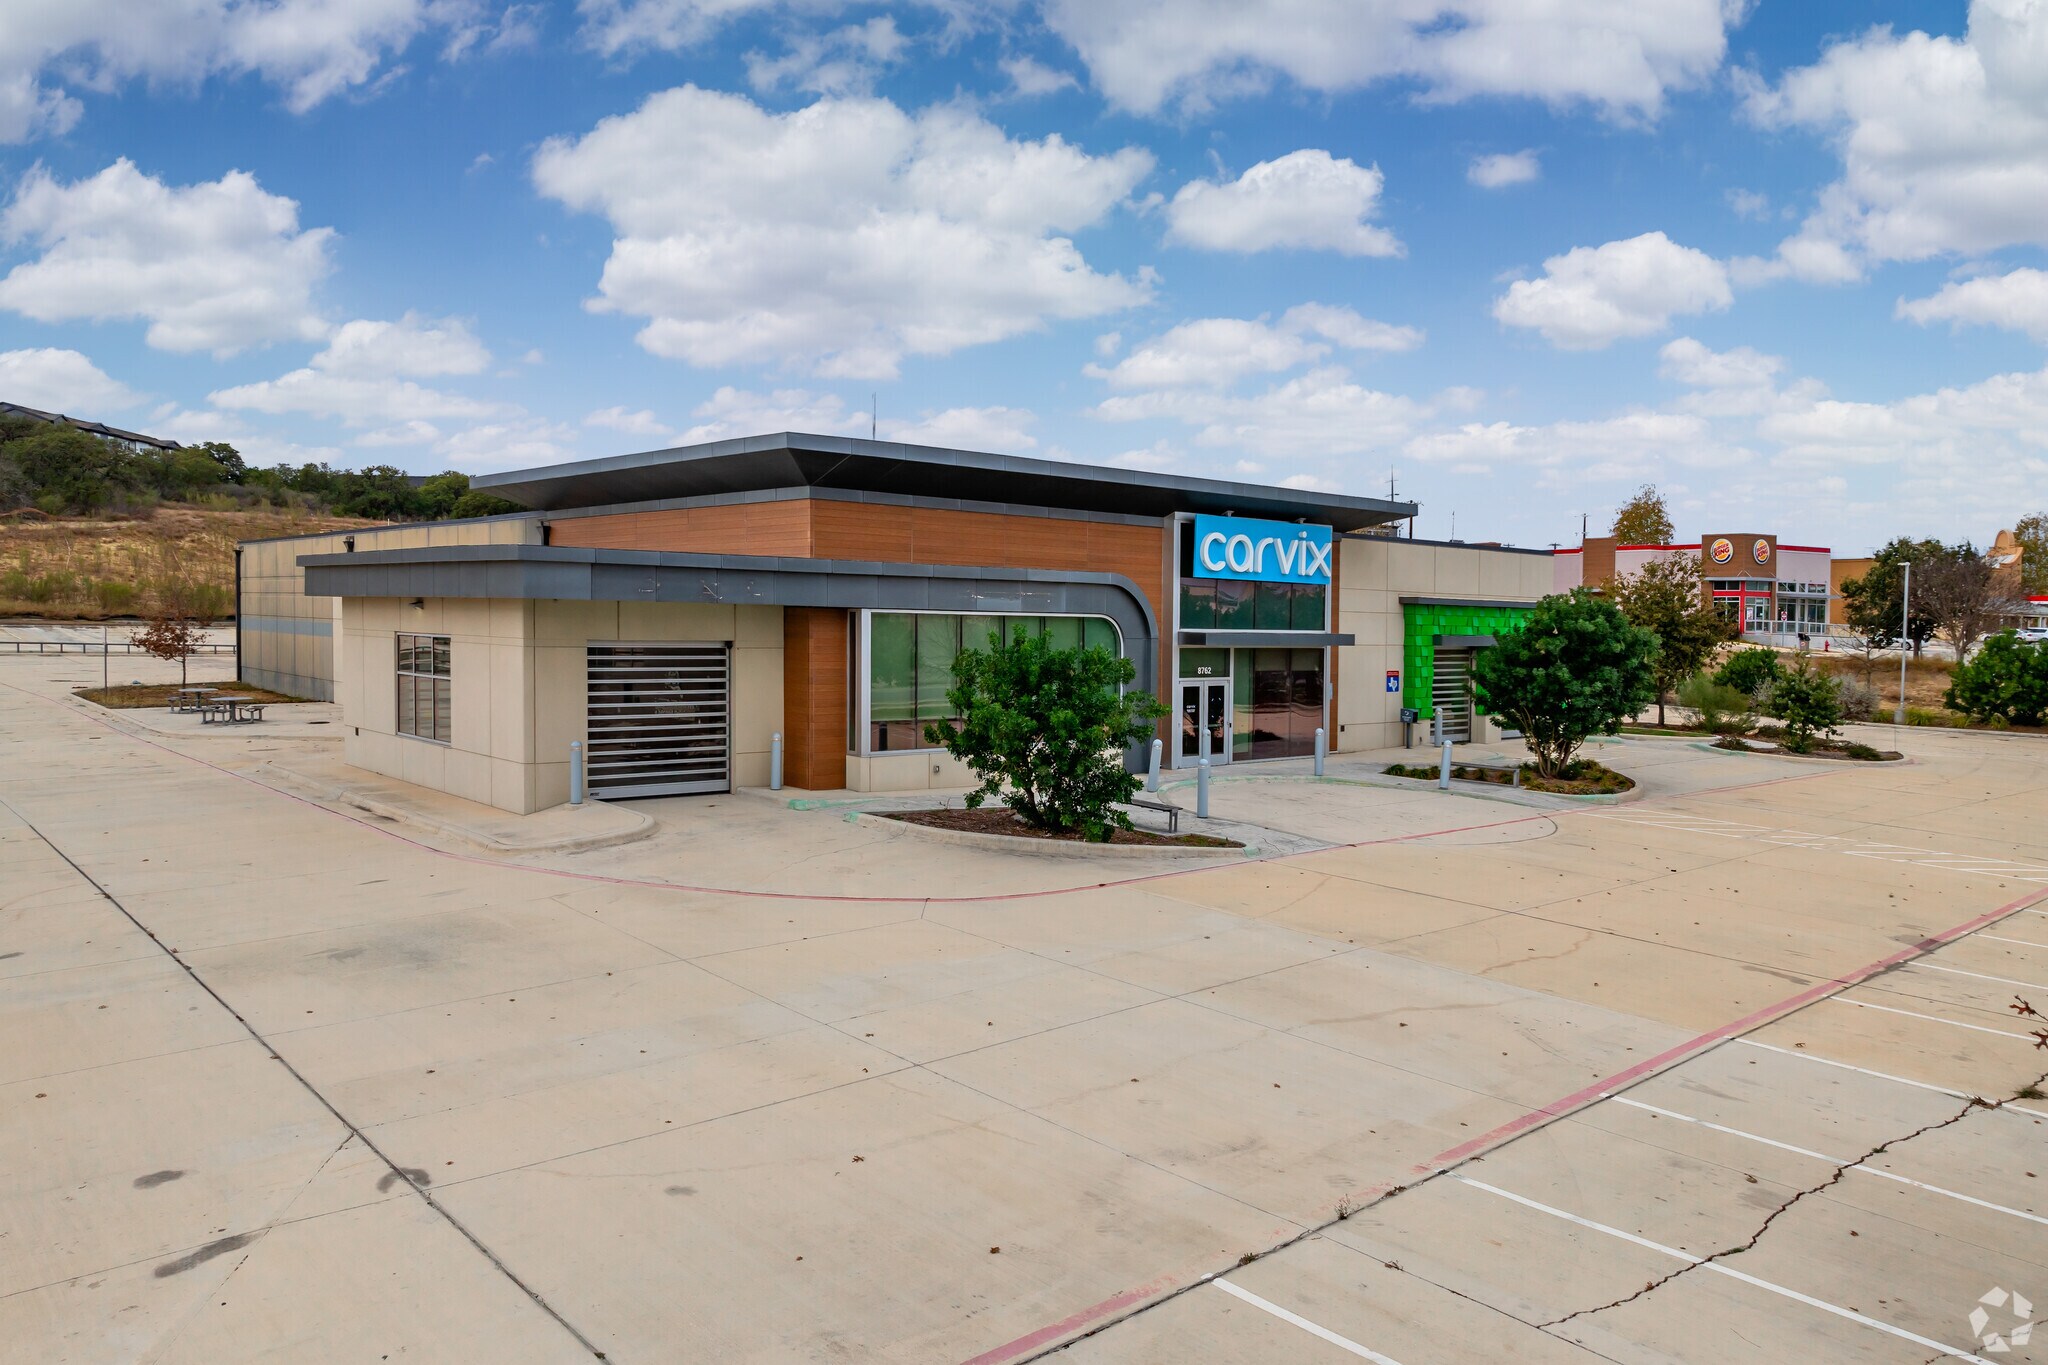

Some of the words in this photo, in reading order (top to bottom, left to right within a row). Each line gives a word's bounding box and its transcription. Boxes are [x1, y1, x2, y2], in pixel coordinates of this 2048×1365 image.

[1200, 531, 1332, 577] carvix
[1714, 547, 1729, 557] KING
[1197, 666, 1212, 675] 8762
